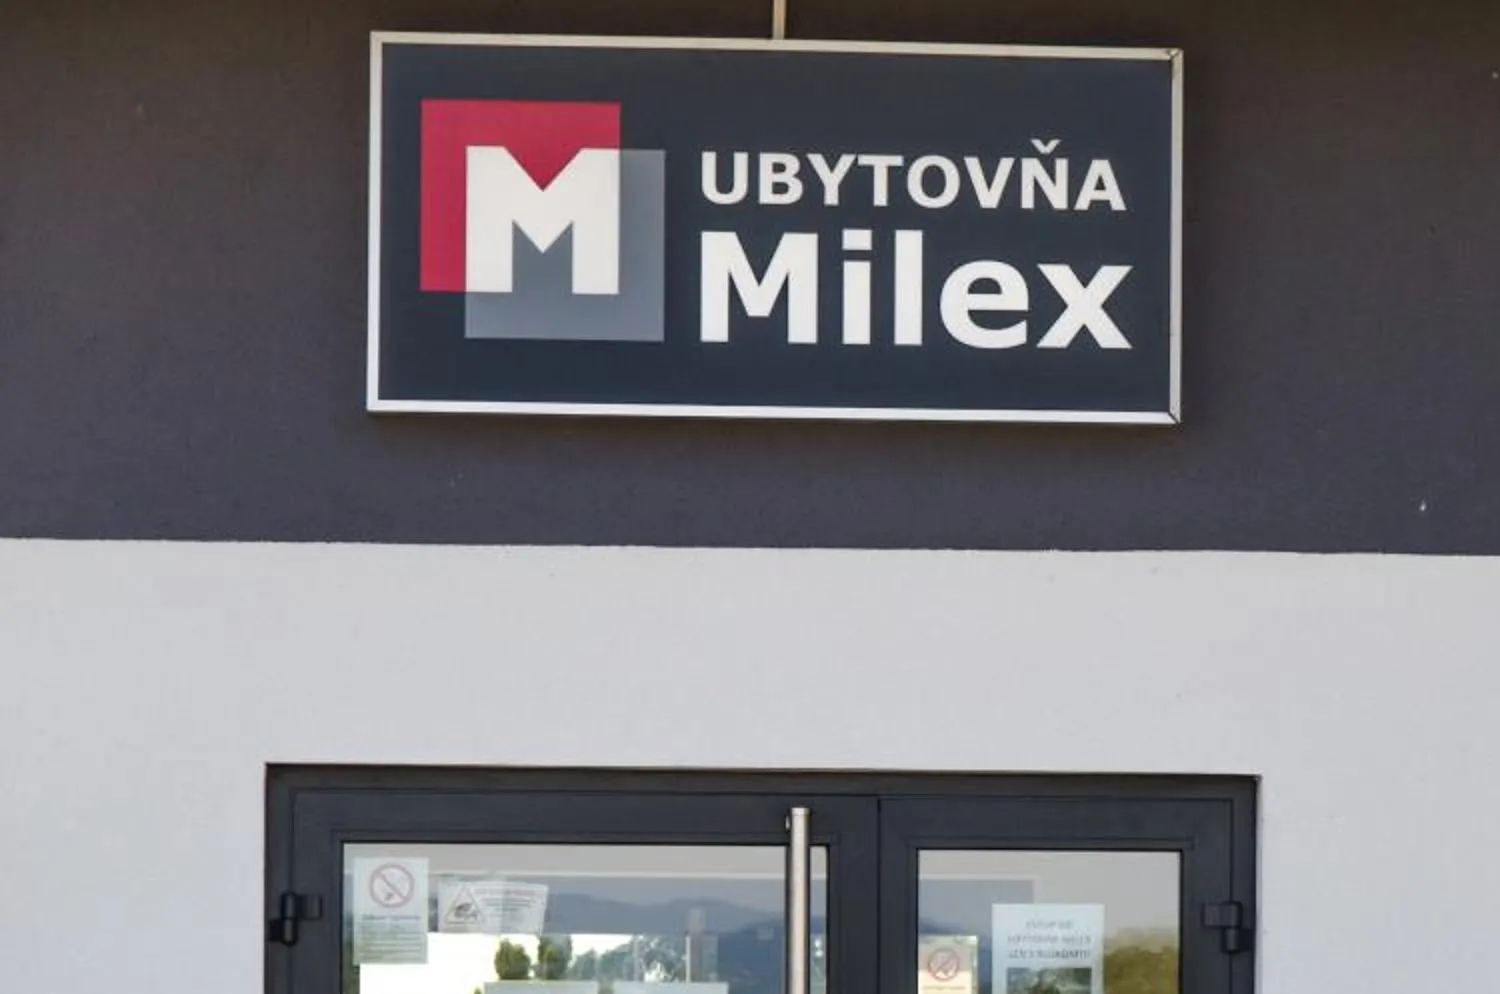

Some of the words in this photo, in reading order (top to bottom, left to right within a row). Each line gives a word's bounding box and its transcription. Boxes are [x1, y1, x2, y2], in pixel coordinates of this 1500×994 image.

[465, 145, 620, 295] M
[699, 138, 1128, 212] UBYTOVŇA
[699, 229, 1134, 349] Milex
